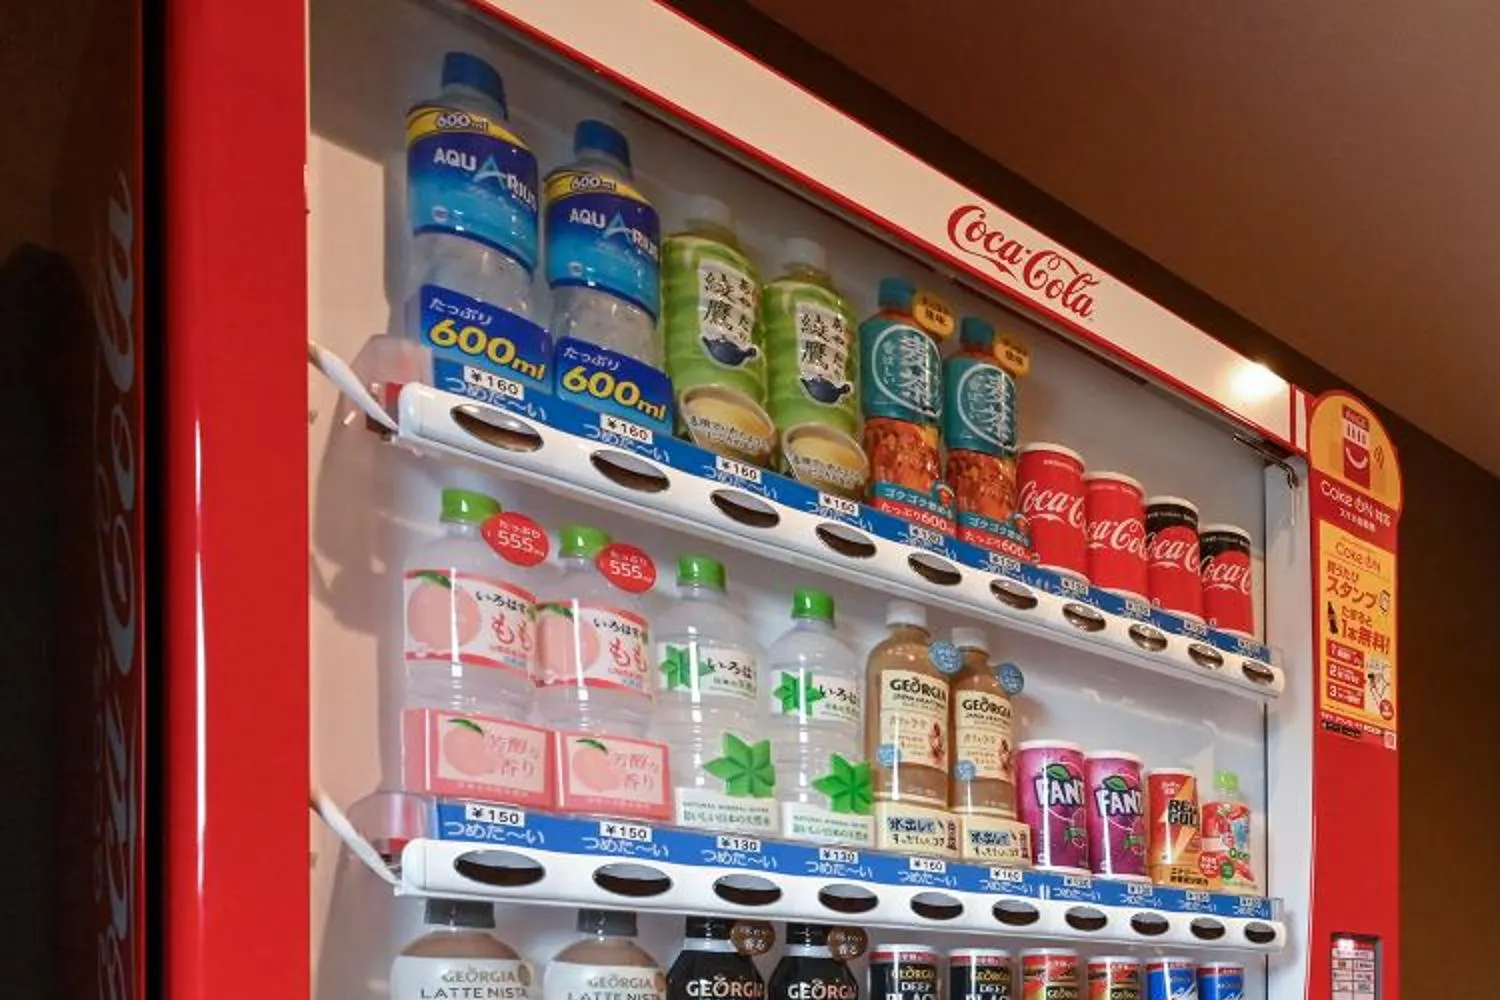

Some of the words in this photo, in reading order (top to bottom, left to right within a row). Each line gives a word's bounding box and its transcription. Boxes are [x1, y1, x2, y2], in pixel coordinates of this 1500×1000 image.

[947, 205, 1100, 321] Coca-Cola
[427, 297, 492, 326] たっぷり
[429, 318, 547, 383] 600ml
[562, 345, 620, 371] たっぷり
[471, 368, 519, 396] ¥160
[562, 365, 666, 421] 600ml
[607, 419, 648, 441] ¥160
[1327, 575, 1378, 609] スタンプ
[472, 808, 519, 825] ¥150
[606, 824, 648, 840] ¥150
